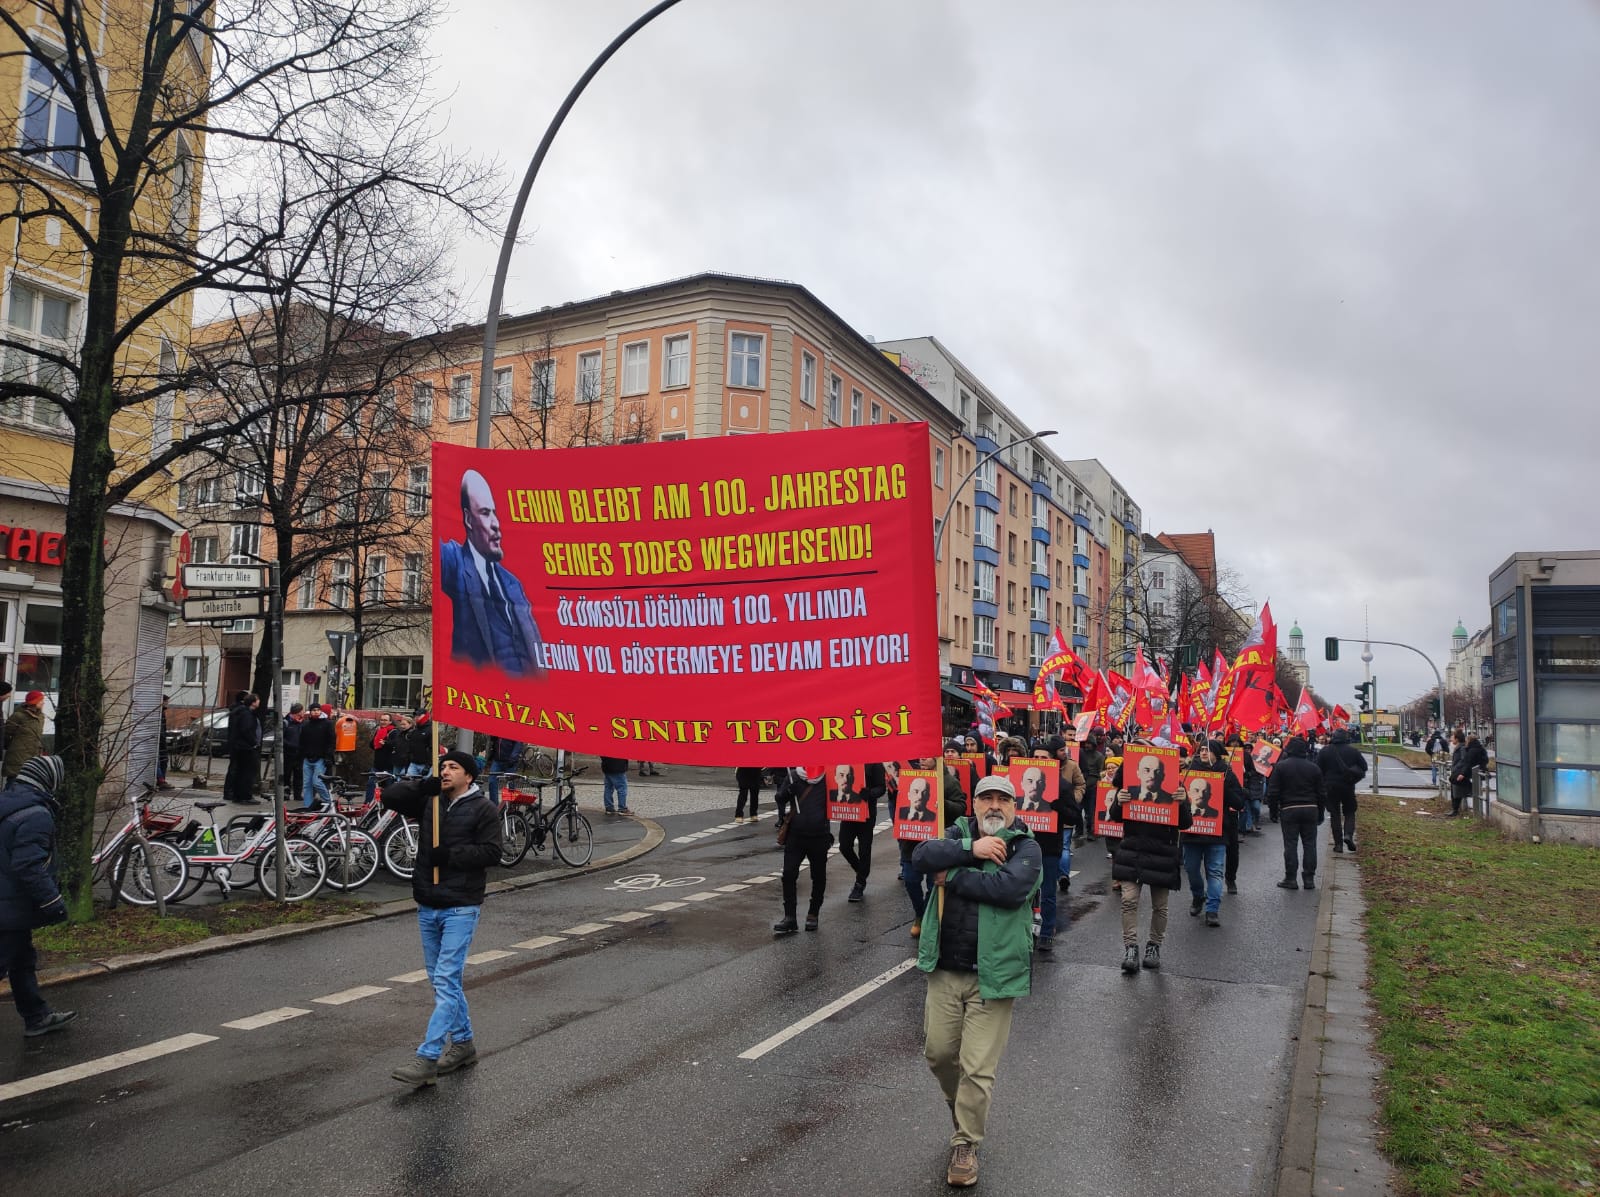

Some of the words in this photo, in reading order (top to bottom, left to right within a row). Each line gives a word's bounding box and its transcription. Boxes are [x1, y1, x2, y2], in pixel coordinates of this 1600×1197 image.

[507, 489, 565, 524] LENIN
[568, 486, 642, 524] BLEIBT
[653, 484, 691, 521] AM
[698, 478, 756, 518] 100.
[764, 463, 907, 512] JAHRESTAG
[542, 542, 615, 577] SEINES
[619, 539, 693, 574] TODES
[700, 523, 873, 571] WEGWEISEND!
[196, 569, 233, 582] Frankfurter
[235, 570, 251, 582] Allee
[202, 600, 242, 614] Colbestraße
[557, 592, 725, 628] ÖLÜMSÜZLÜĞÜNÜN
[732, 594, 777, 625] 100.
[784, 587, 868, 622] YILINDA
[533, 639, 580, 672] LENİN
[582, 645, 616, 674] YOL
[620, 641, 744, 675] GÖSTERMEYE
[750, 639, 823, 673] DEVAM
[829, 633, 910, 668] EDIYOR!
[446, 685, 577, 734] PARTİZAN
[611, 717, 713, 743] SINIF
[726, 705, 913, 744] TEORİSİ
